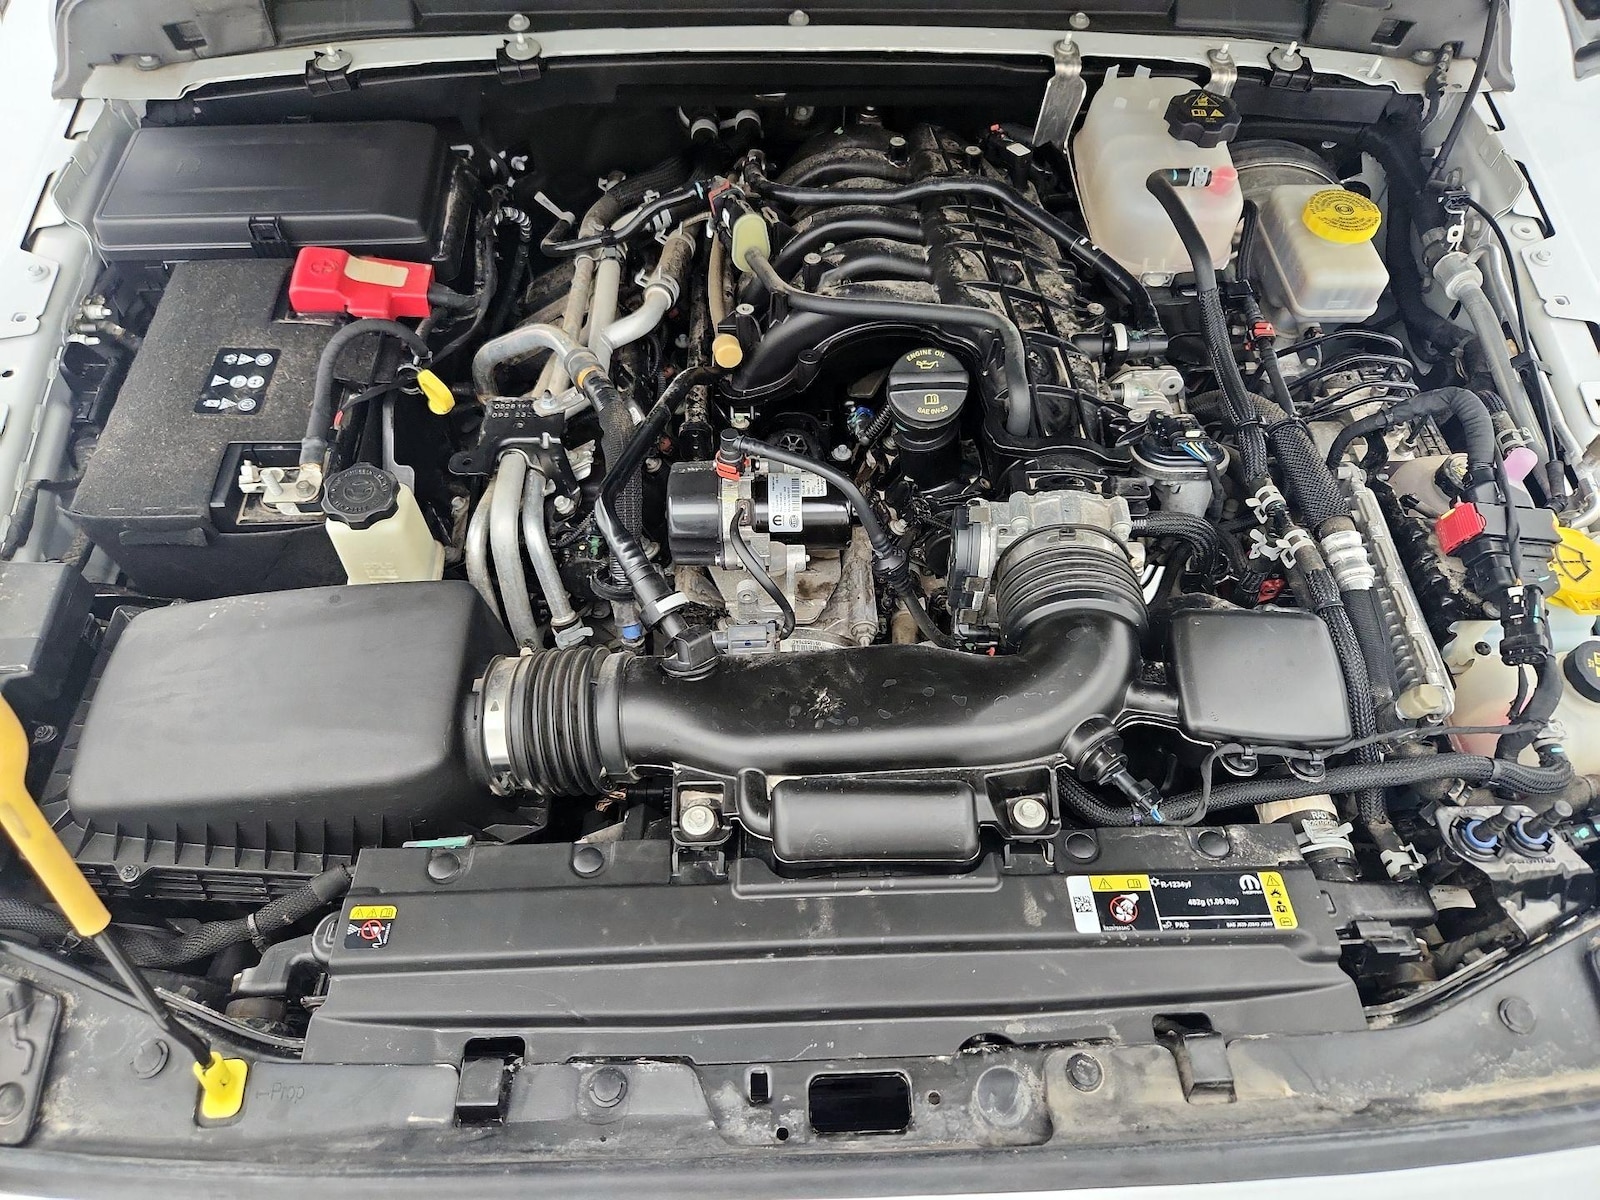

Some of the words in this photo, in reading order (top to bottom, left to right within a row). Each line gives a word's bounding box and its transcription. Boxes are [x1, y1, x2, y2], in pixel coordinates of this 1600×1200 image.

[906, 349, 932, 361] ENGINE
[934, 350, 946, 359] OIL
[917, 406, 930, 415] SAE
[930, 405, 949, 415] 0W-20
[1225, 898, 1240, 907] lbs)
[1175, 921, 1190, 929] PAG
[270, 1081, 305, 1104] Prop
